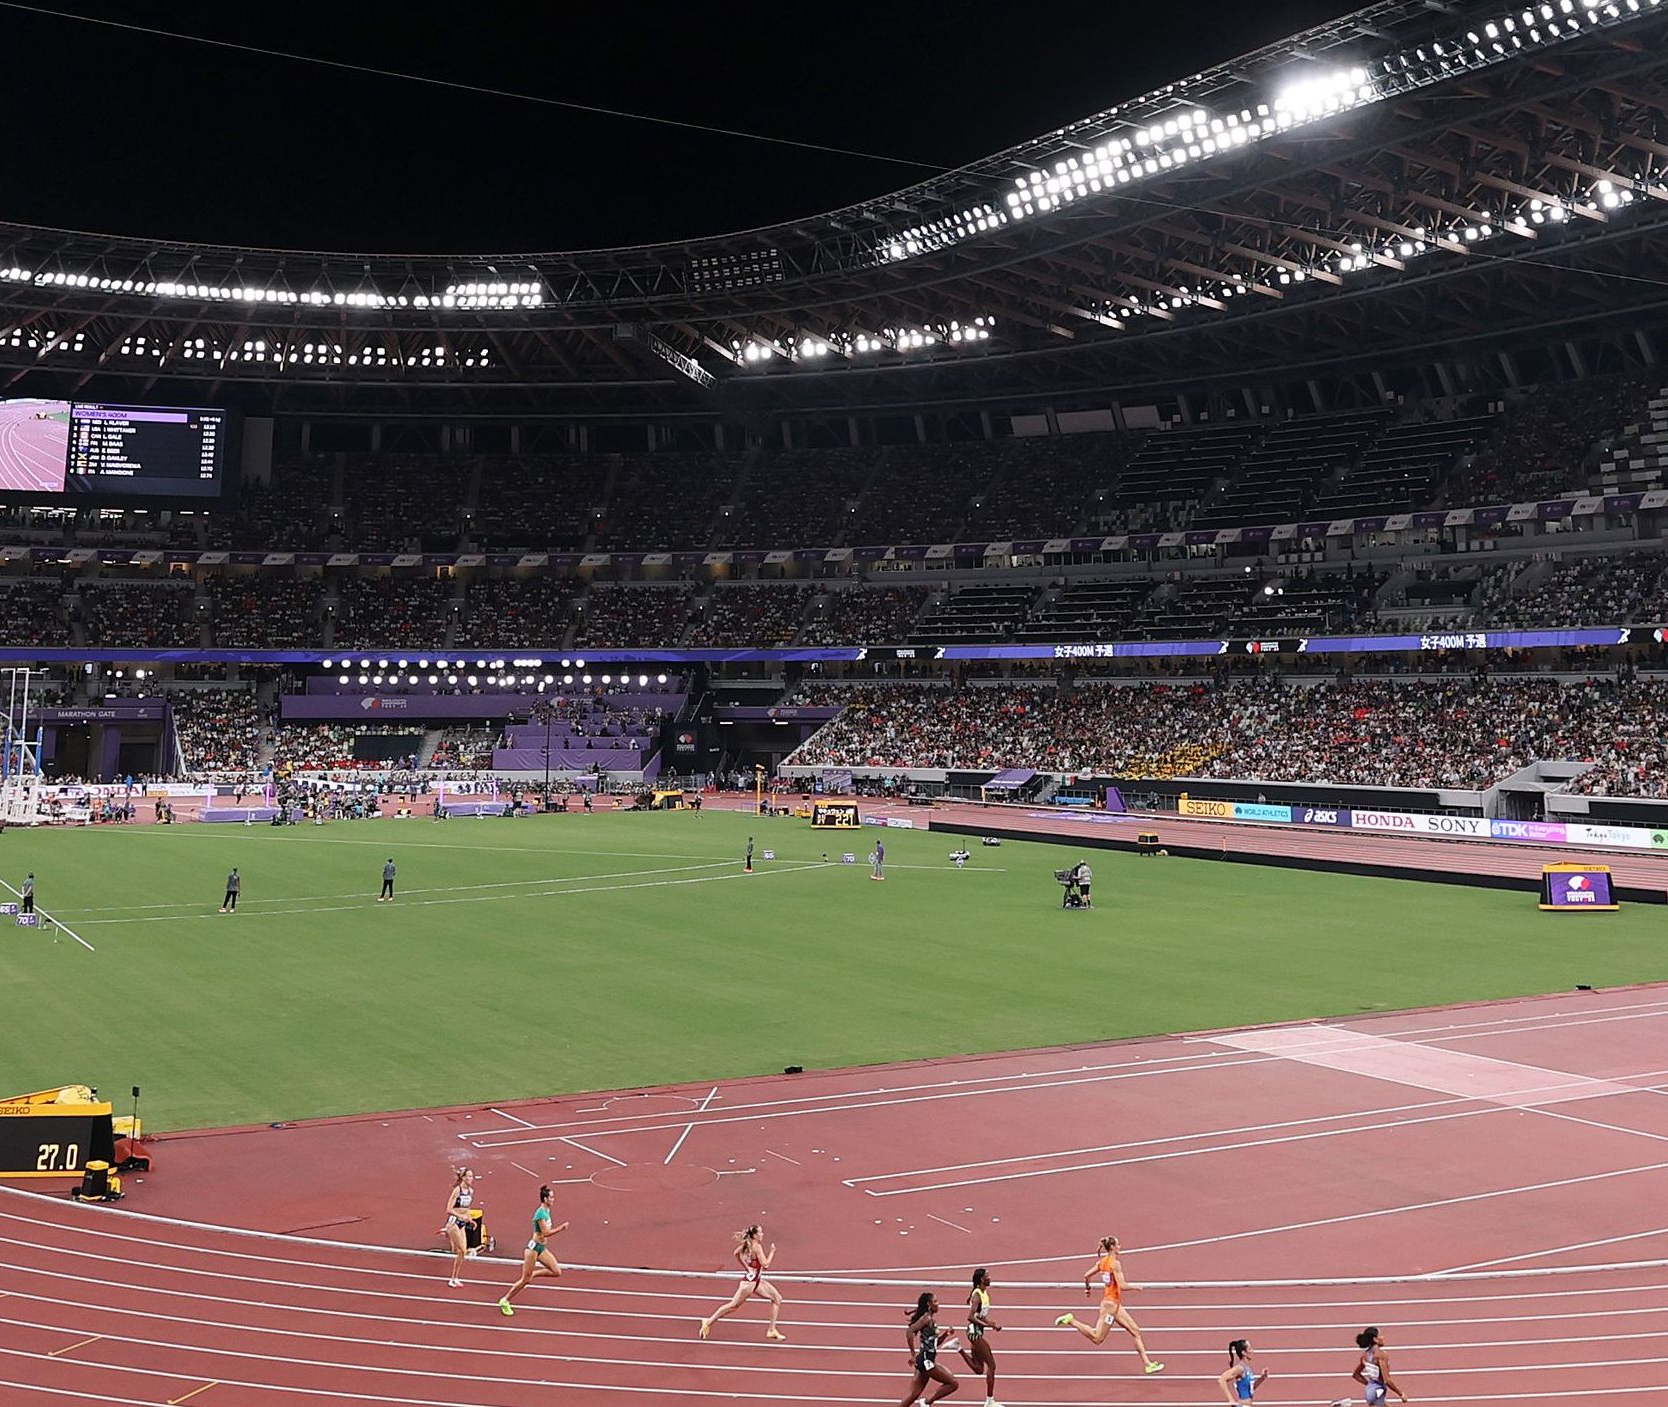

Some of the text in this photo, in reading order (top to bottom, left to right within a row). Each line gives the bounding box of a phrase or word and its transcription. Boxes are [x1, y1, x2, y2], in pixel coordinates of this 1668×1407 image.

[1420, 634, 1464, 650] 女子400M
[1054, 645, 1093, 658] 女子400M
[98, 710, 116, 718] GATE
[93, 786, 140, 797] ONDA
[1186, 801, 1226, 816] SEIKO
[1243, 808, 1289, 818] WORLD ATHLETICS
[835, 814, 853, 826] 221
[1313, 809, 1337, 824] asics
[1355, 813, 1415, 829] HONDA
[1428, 817, 1480, 833] SONY
[1499, 823, 1528, 837] TDK
[36, 1144, 78, 1170] 27.0
